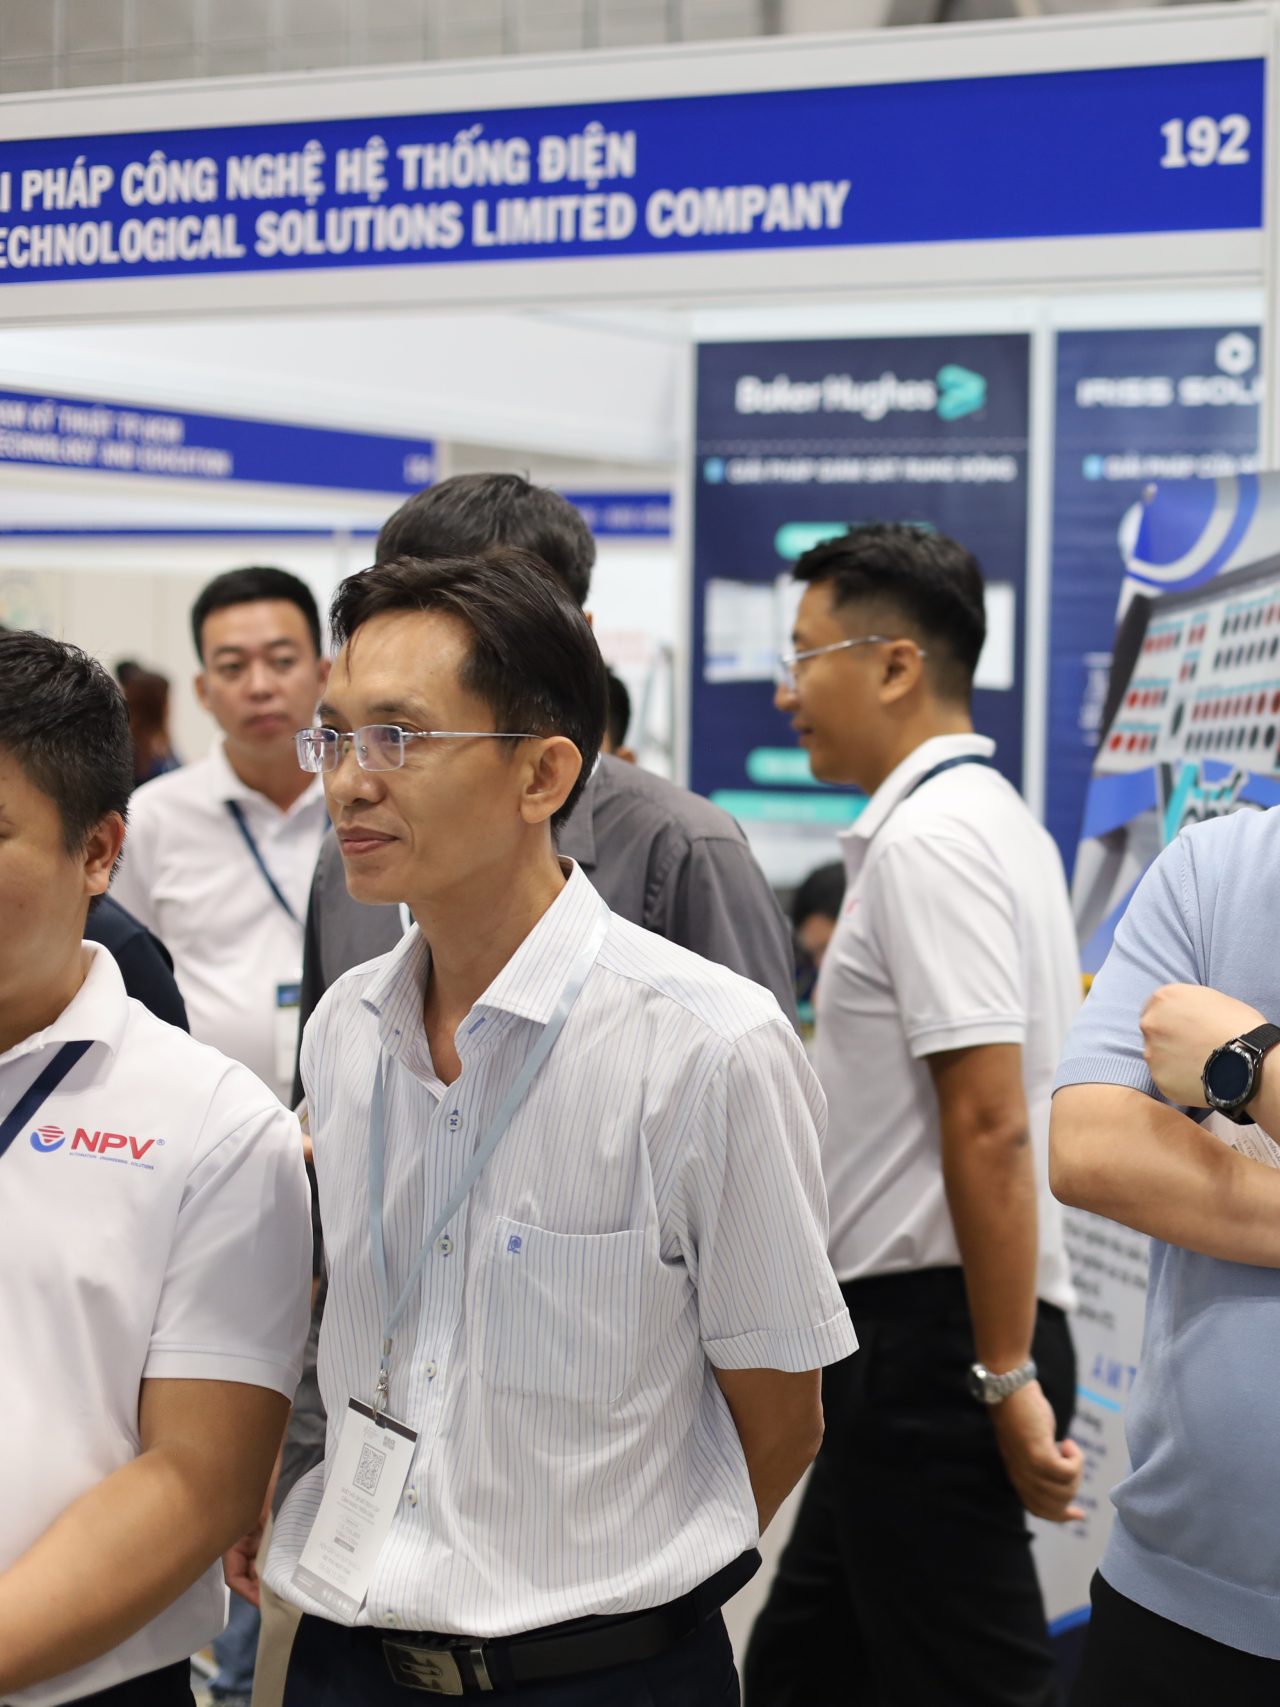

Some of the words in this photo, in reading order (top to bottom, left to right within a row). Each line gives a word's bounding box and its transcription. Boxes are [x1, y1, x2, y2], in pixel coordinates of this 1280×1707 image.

[22, 155, 113, 211] PHÁP
[121, 150, 217, 206] CÔNG
[227, 140, 325, 206] NGHỆ
[335, 136, 388, 201] HỆ
[397, 125, 530, 190] THỐNG
[538, 122, 636, 192] ĐIỆN
[1161, 114, 1249, 168] 192
[255, 202, 463, 257] SOLUTIONS
[472, 193, 636, 246] LIMITED
[646, 181, 850, 238] COMPANY
